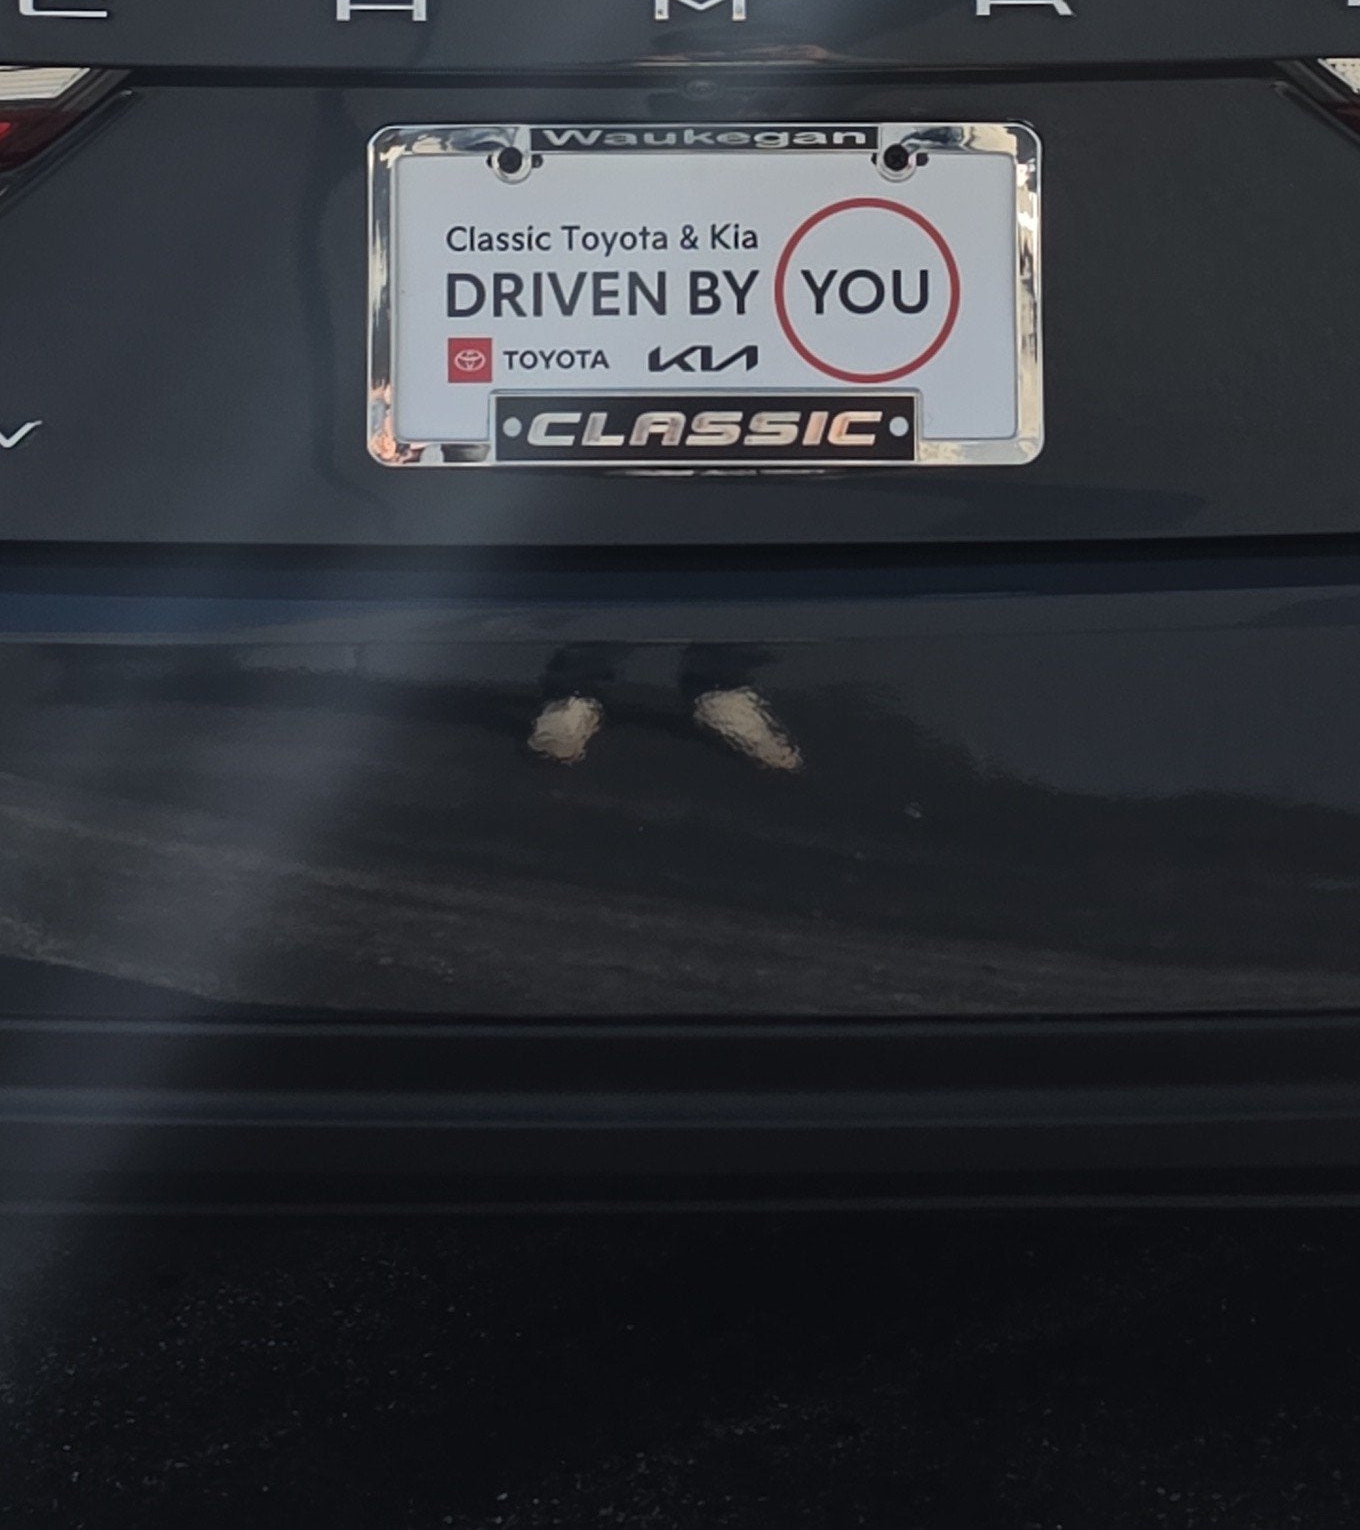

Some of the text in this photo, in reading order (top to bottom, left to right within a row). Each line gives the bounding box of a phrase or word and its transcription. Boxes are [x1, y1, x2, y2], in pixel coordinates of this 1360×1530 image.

[542, 128, 867, 149] Waukegan
[446, 223, 760, 257] Classic Toyota & Kia
[446, 269, 930, 318] DRIVEN BY YOU
[503, 345, 759, 372] TOYOTA KIA
[526, 410, 883, 447] CLASSIC
